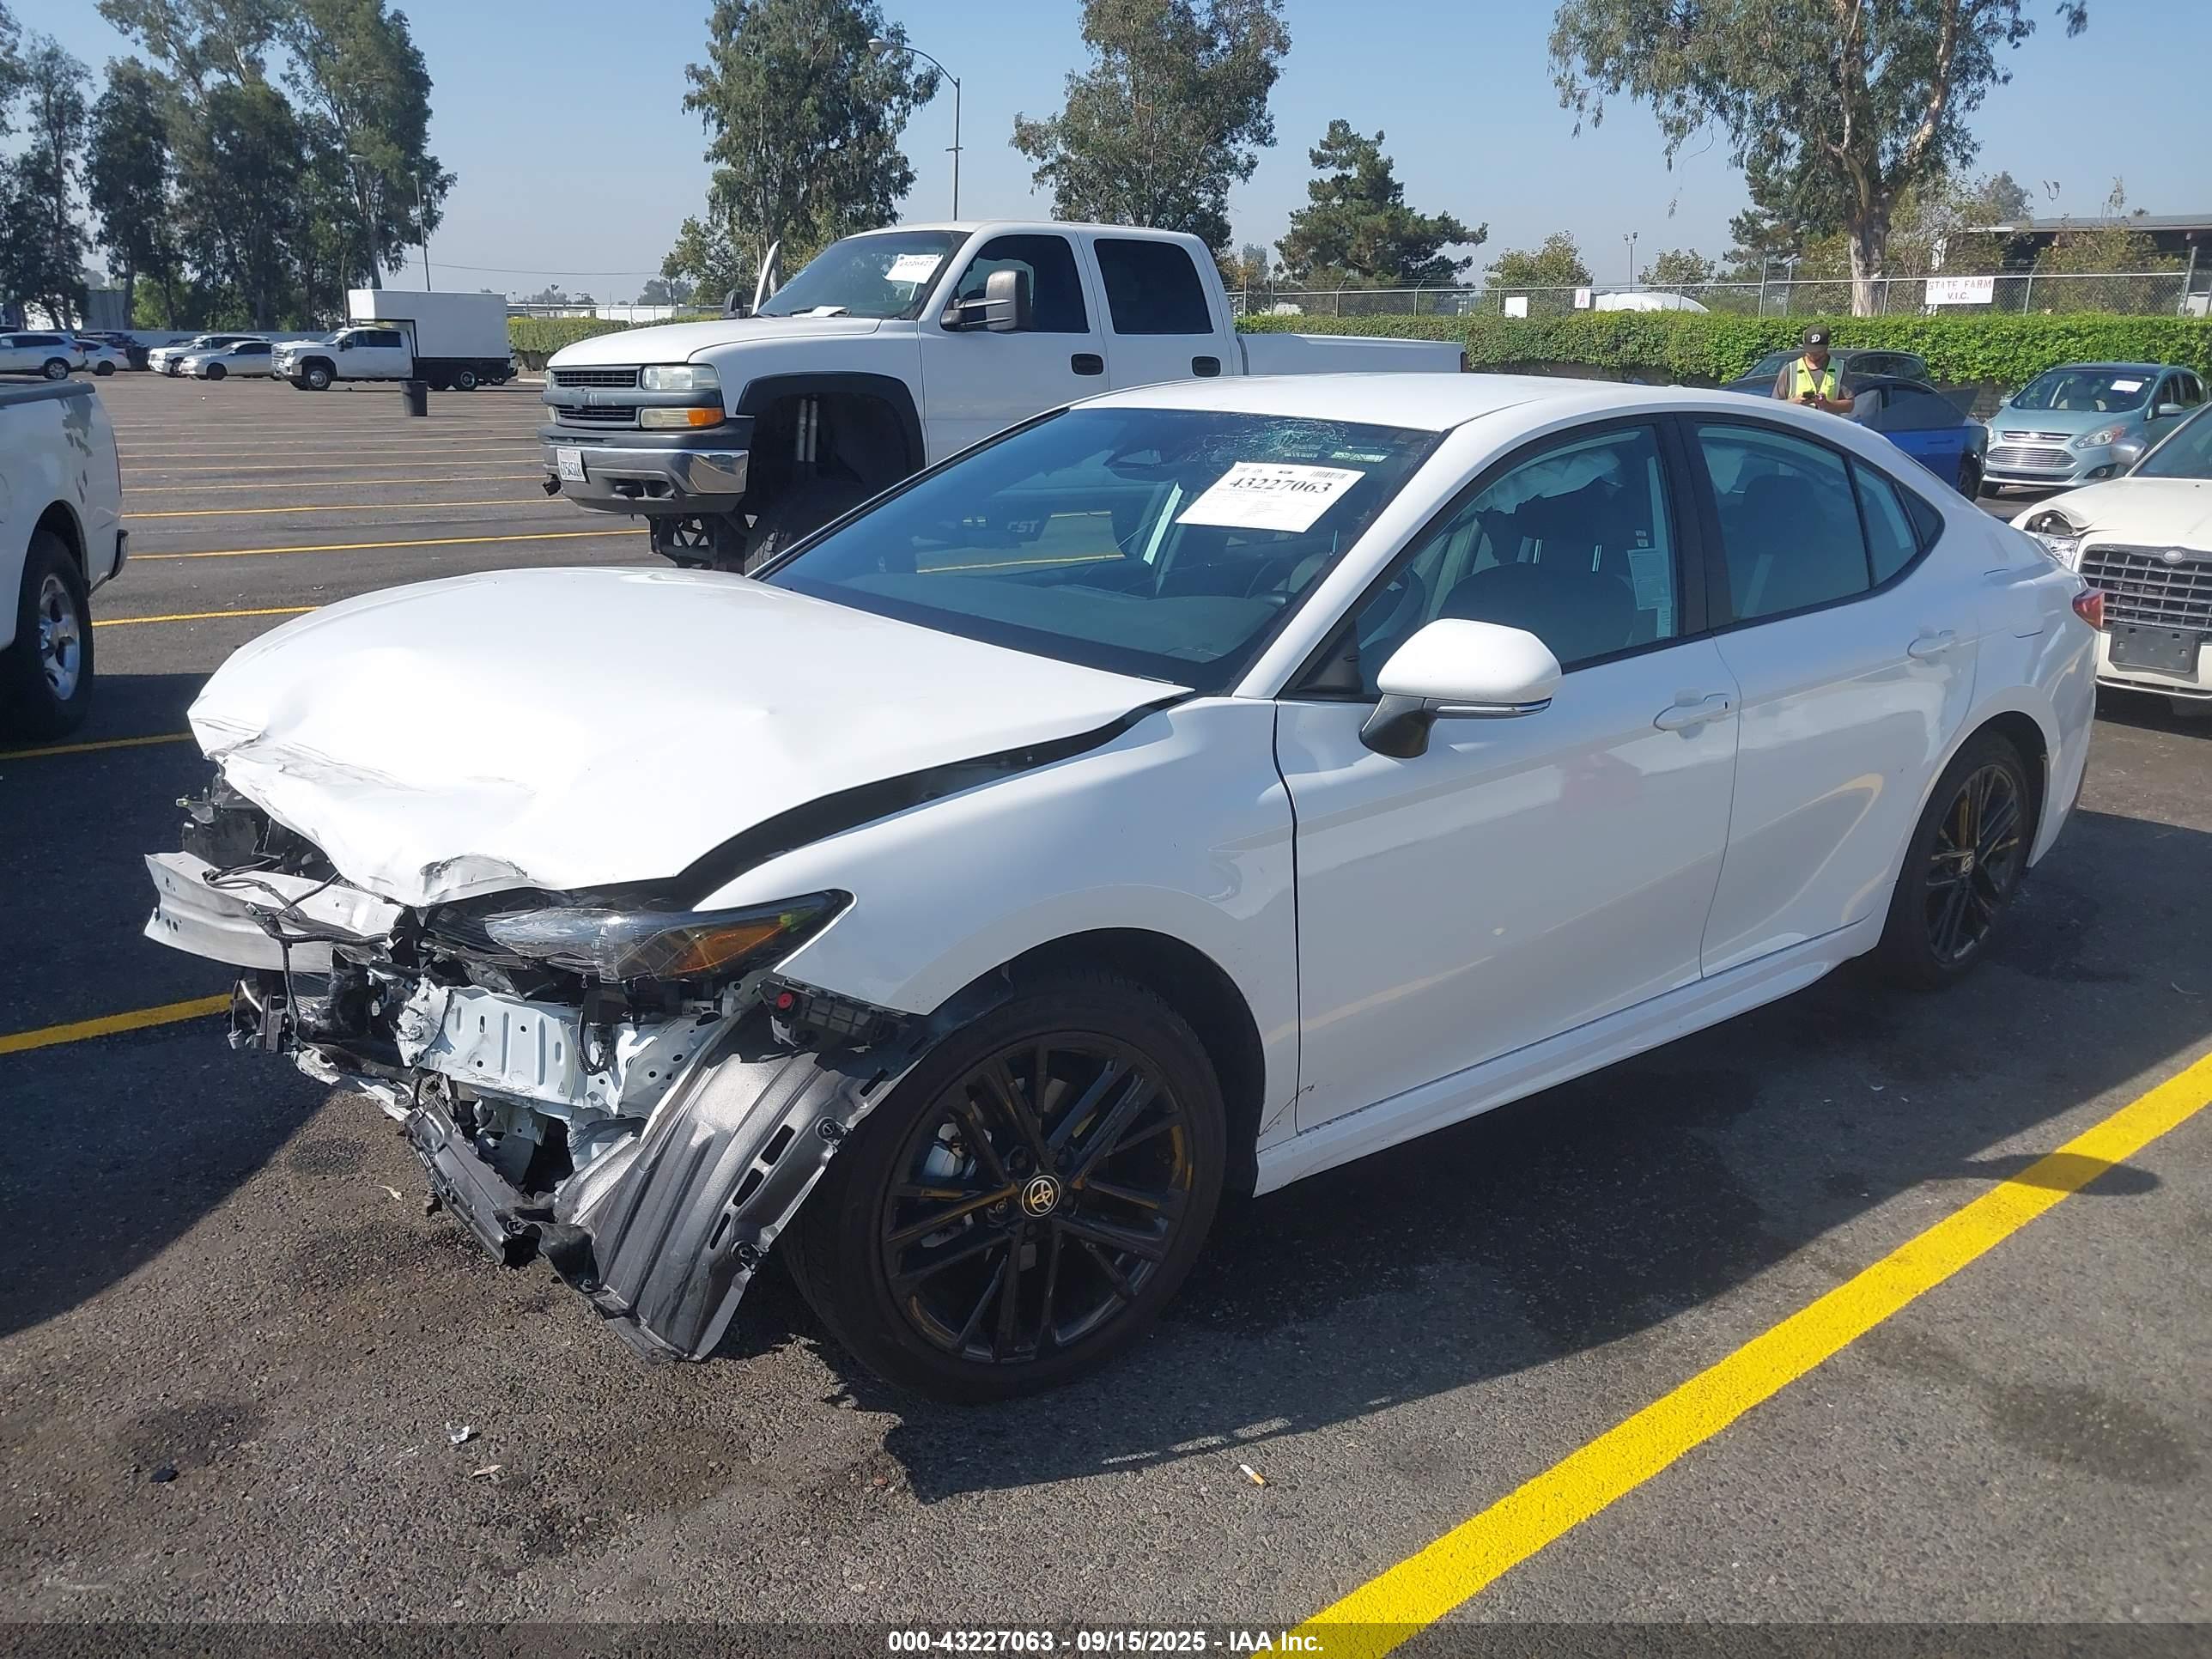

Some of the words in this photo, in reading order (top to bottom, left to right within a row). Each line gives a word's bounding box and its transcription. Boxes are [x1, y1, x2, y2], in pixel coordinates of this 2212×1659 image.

[1928, 280, 1959, 290] STATE
[1964, 279, 1992, 289] FARM
[1947, 291, 1970, 300] V.I.C.
[1229, 477, 1333, 494] 43227063
